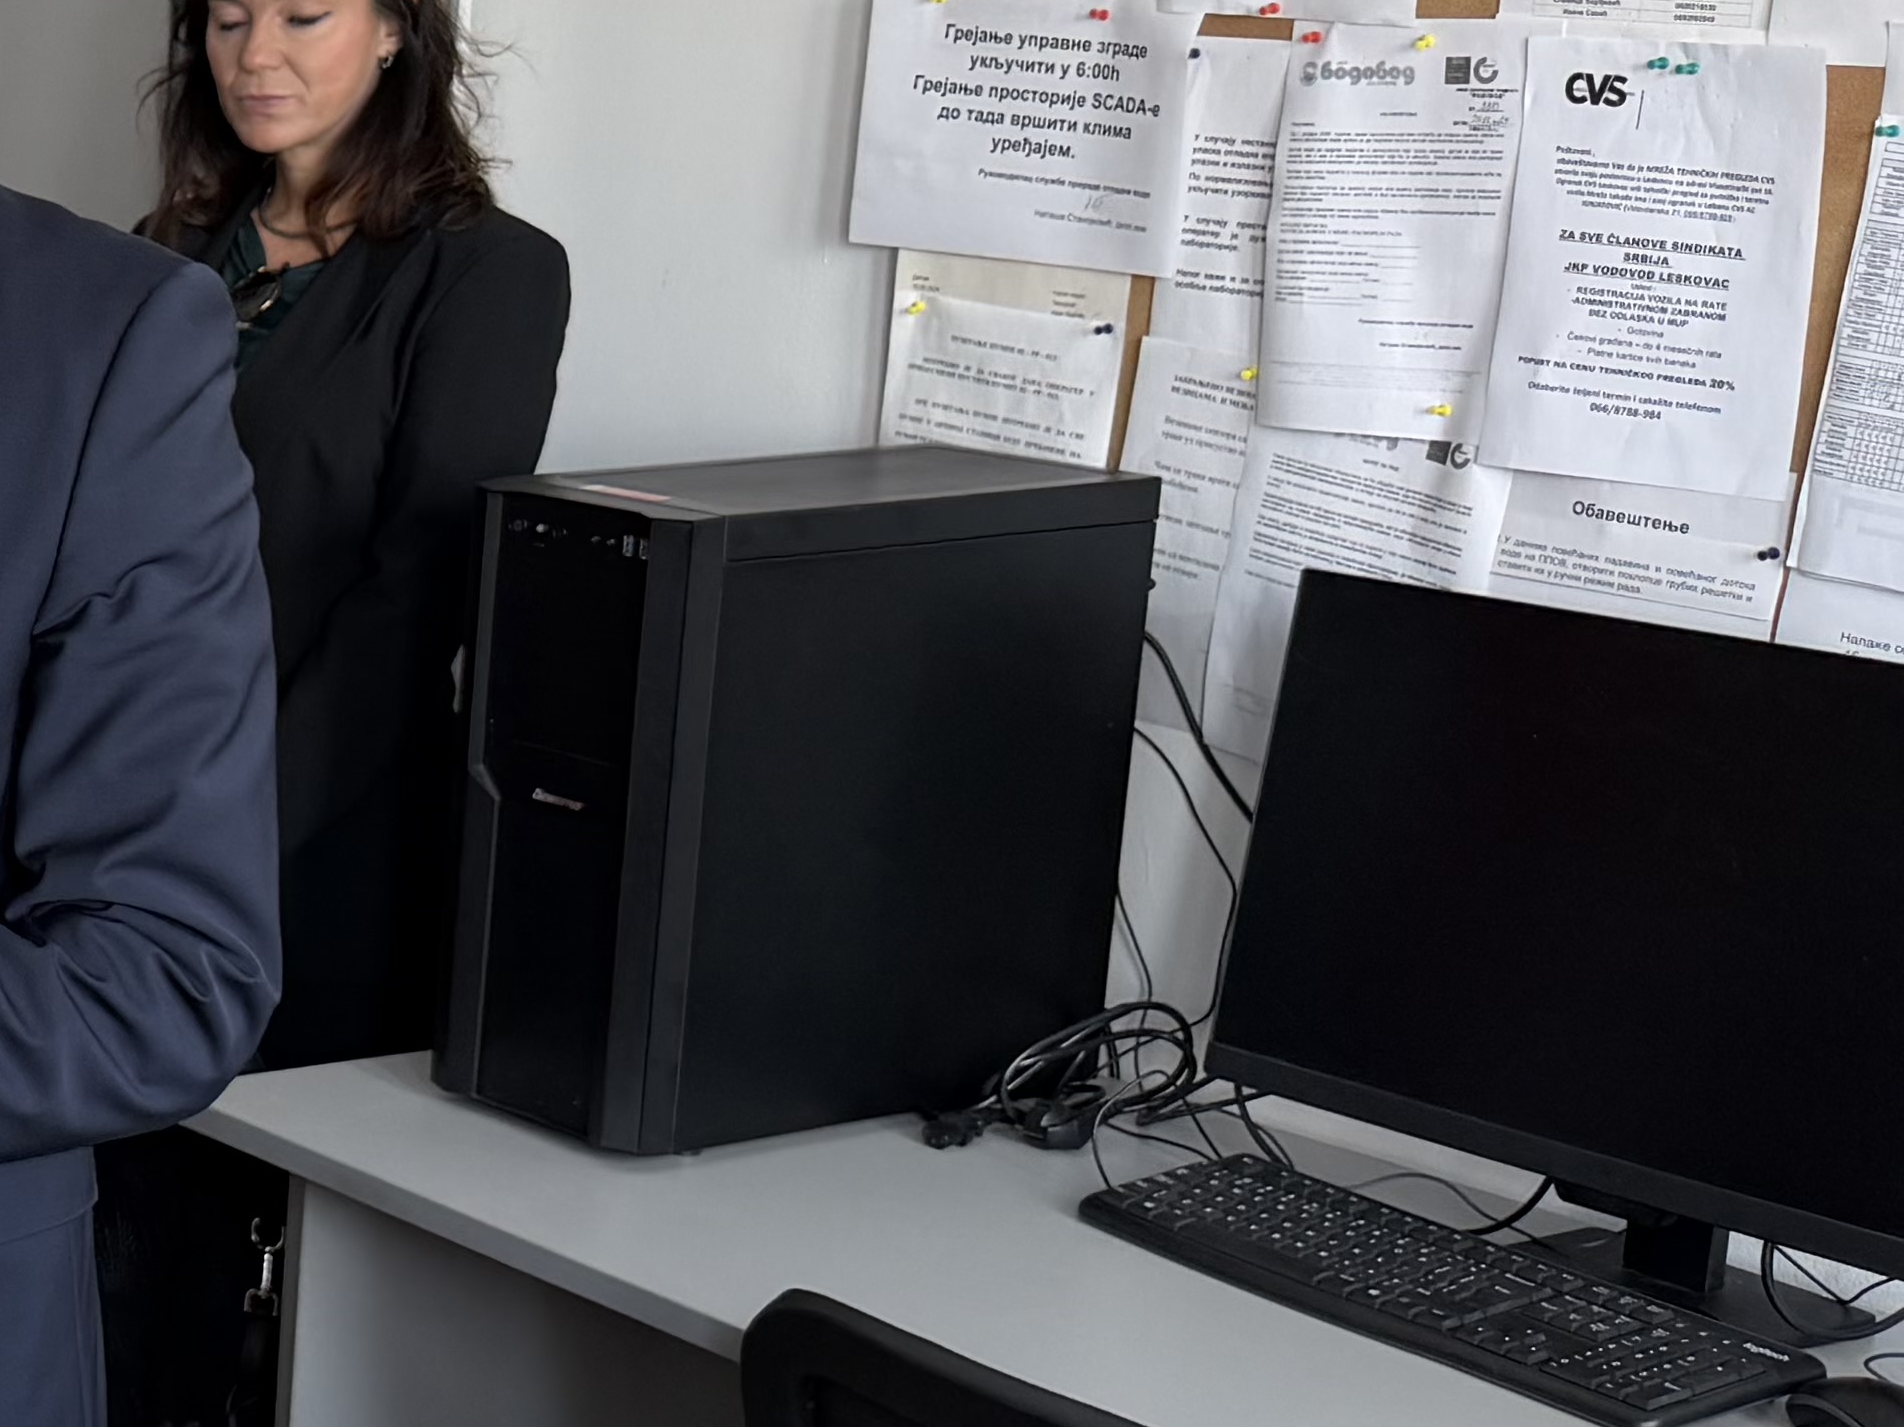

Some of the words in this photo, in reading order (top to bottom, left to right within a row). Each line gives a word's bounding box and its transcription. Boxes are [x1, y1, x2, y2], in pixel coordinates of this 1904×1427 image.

[945, 23, 1013, 47] Грејање
[1018, 31, 1092, 53] управне
[1097, 40, 1148, 60] зграде
[968, 53, 1054, 75] укључити
[1060, 62, 1071, 80] у
[1076, 61, 1121, 83] 6:00h
[913, 74, 983, 98] Грејање
[988, 84, 1086, 111] просторије
[1565, 72, 1629, 108] CVS
[937, 105, 961, 121] до
[967, 109, 1005, 126] тада
[1010, 114, 1078, 136] вршити
[1082, 121, 1132, 140] клима
[990, 135, 1076, 160] уређајем.
[1559, 228, 1575, 240] ZA
[1579, 230, 1604, 243] SVE
[1607, 232, 1667, 250] ČLANOVE
[1671, 241, 1743, 258] SINDIKATA
[1623, 252, 1669, 267] SRBIJA
[1564, 261, 1588, 274] JKP
[1592, 264, 1655, 280] VODOVOD
[1659, 273, 1730, 290] LESKOVAC
[1576, 286, 1645, 302] REGISTRACIJA
[1647, 292, 1682, 306] VOZILA
[1685, 298, 1698, 308] NA
[1701, 299, 1727, 312] RATE
[1588, 308, 1607, 319] BEZ
[1572, 500, 1690, 535] Обавештење
